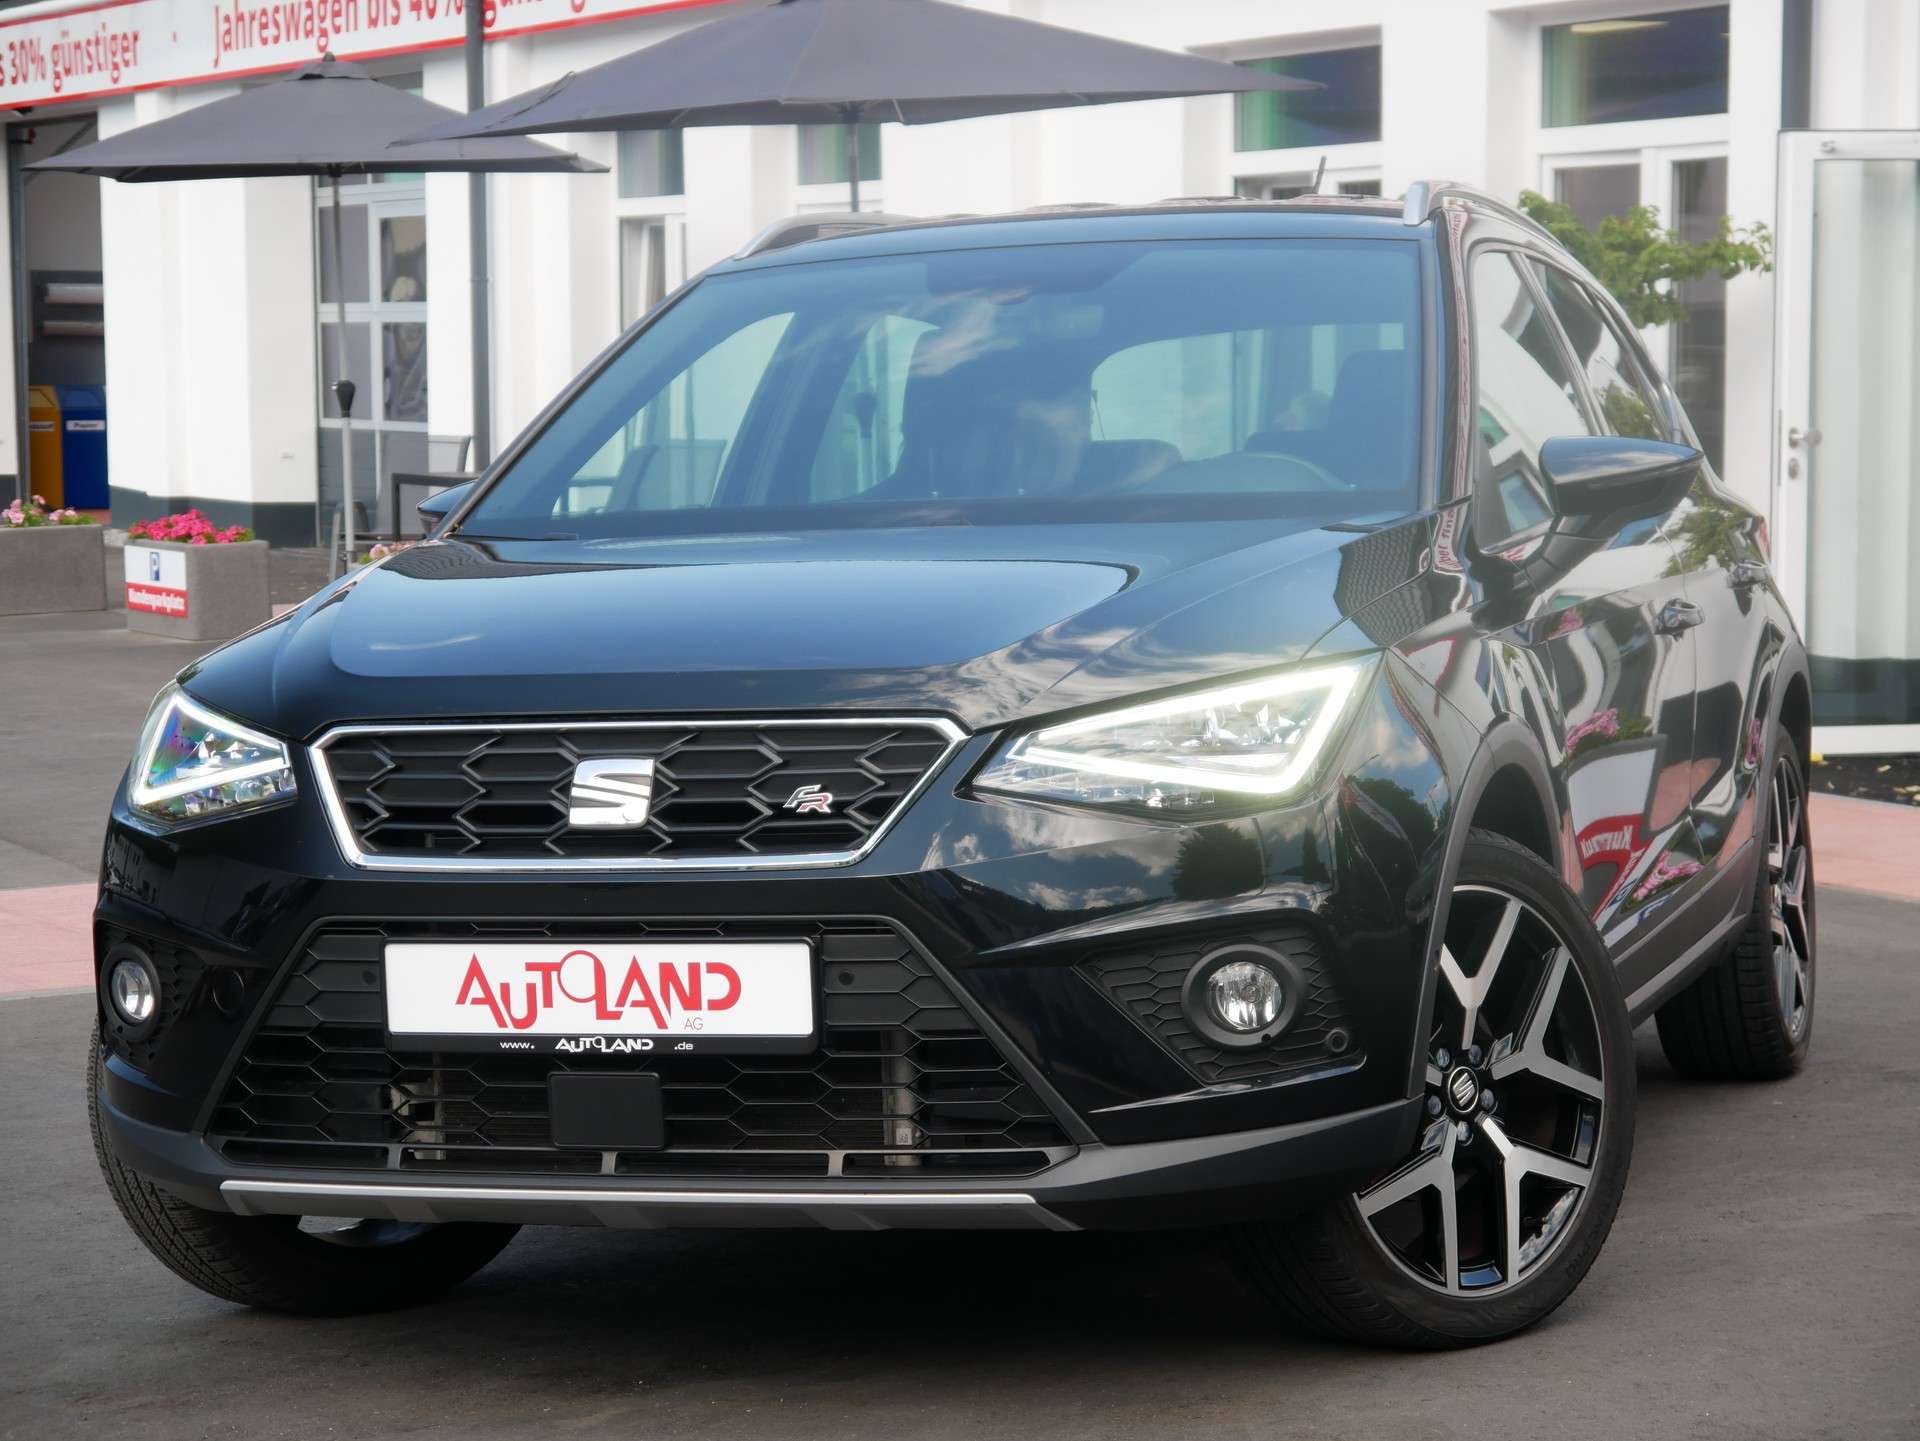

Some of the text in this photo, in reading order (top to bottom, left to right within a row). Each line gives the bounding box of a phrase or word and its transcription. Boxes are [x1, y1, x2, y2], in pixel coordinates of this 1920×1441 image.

[8, 36, 47, 85] 30%
[51, 22, 140, 93] günstiger
[213, 0, 358, 68] Jahreswagen
[684, 1016, 704, 1031] AG
